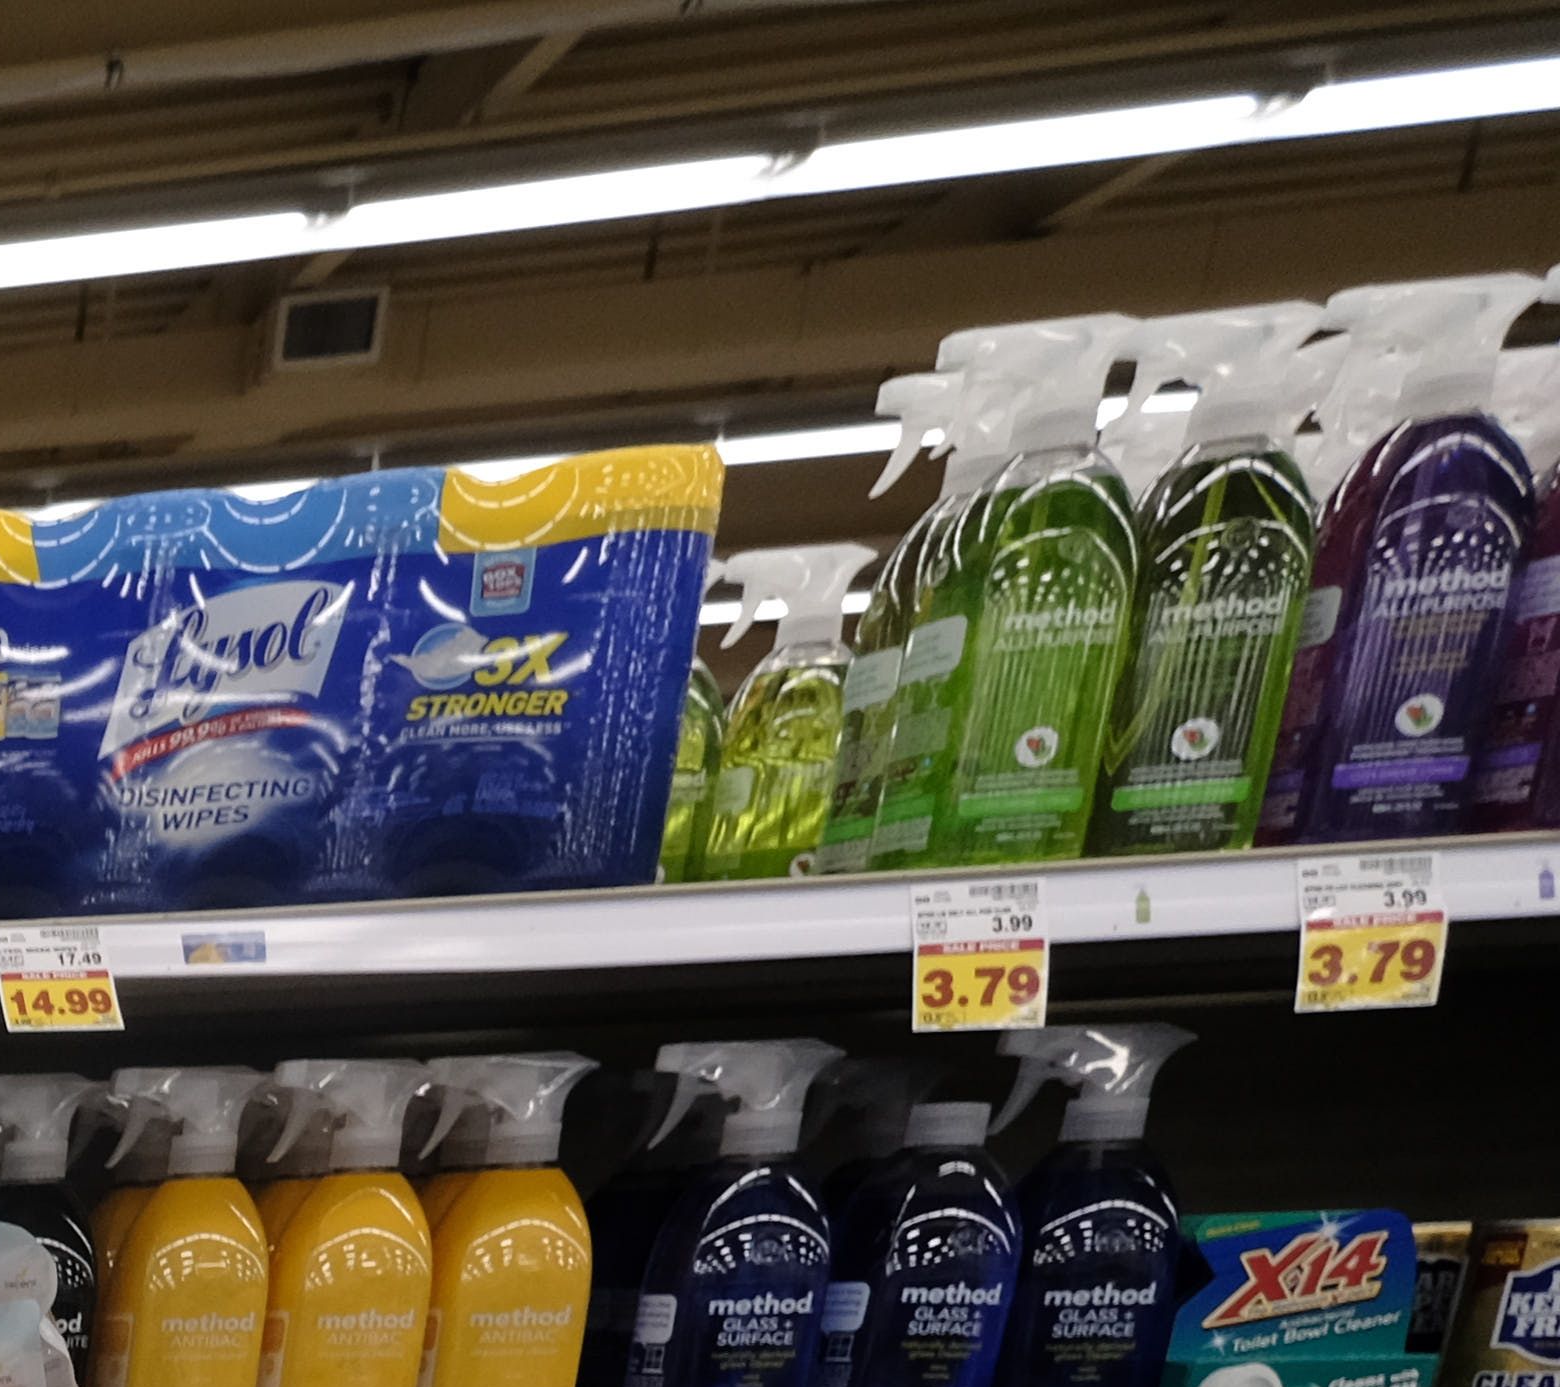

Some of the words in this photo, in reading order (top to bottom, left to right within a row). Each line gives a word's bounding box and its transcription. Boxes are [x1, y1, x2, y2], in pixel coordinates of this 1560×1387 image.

[473, 631, 569, 687] 3X
[406, 689, 569, 720] STRONGER
[121, 778, 311, 806] DISINFECTING
[162, 805, 249, 831] WIPES
[992, 914, 1033, 934] 3.99
[58, 951, 103, 966] 17.49
[922, 964, 1041, 1009] 3.79
[10, 988, 113, 1018] 14.99
[708, 1291, 814, 1316] method
[901, 1282, 1004, 1305] method
[1043, 1282, 1158, 1307] method
